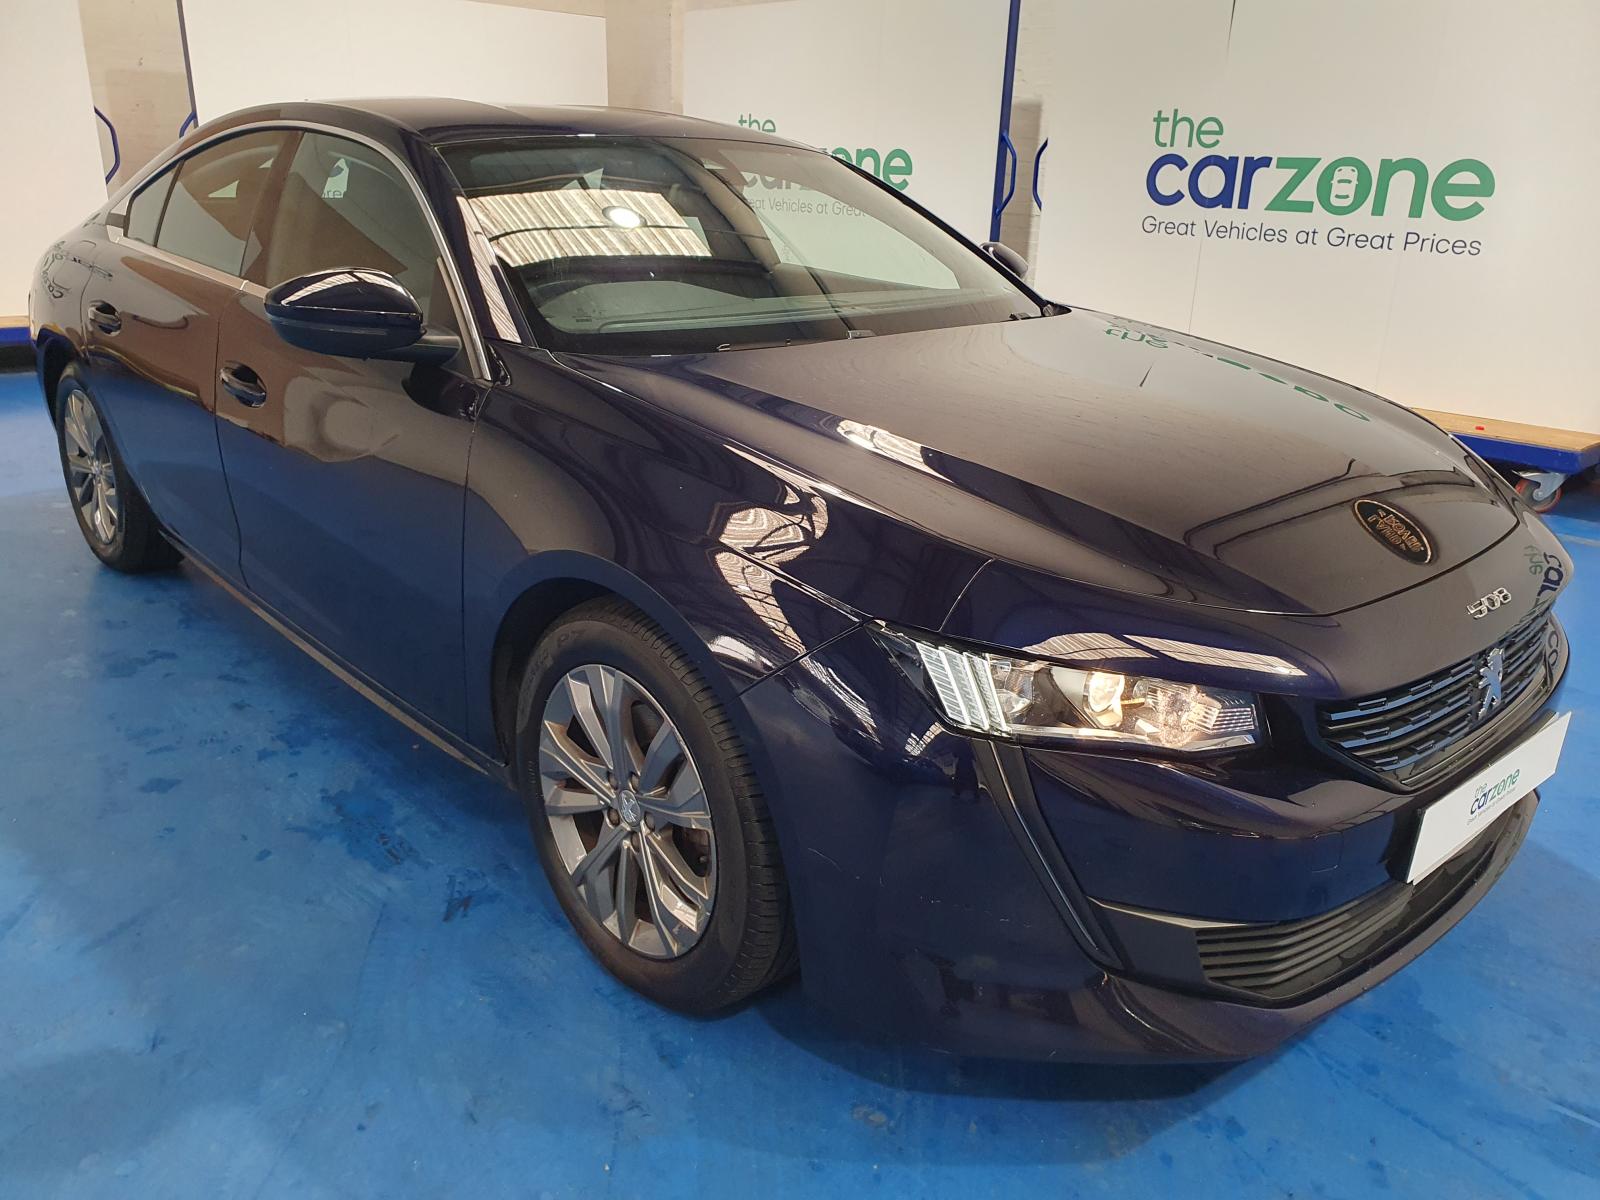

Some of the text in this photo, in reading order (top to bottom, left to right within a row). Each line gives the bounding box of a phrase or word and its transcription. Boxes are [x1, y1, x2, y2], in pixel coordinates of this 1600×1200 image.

[1153, 108, 1224, 148] the
[769, 198, 813, 214] Vehicles
[816, 203, 829, 215] at
[1146, 153, 1496, 222] carzone
[1141, 215, 1482, 256] Great Vehicles at Great Prices
[1466, 587, 1512, 620] 508
[1470, 768, 1520, 816] carzone
